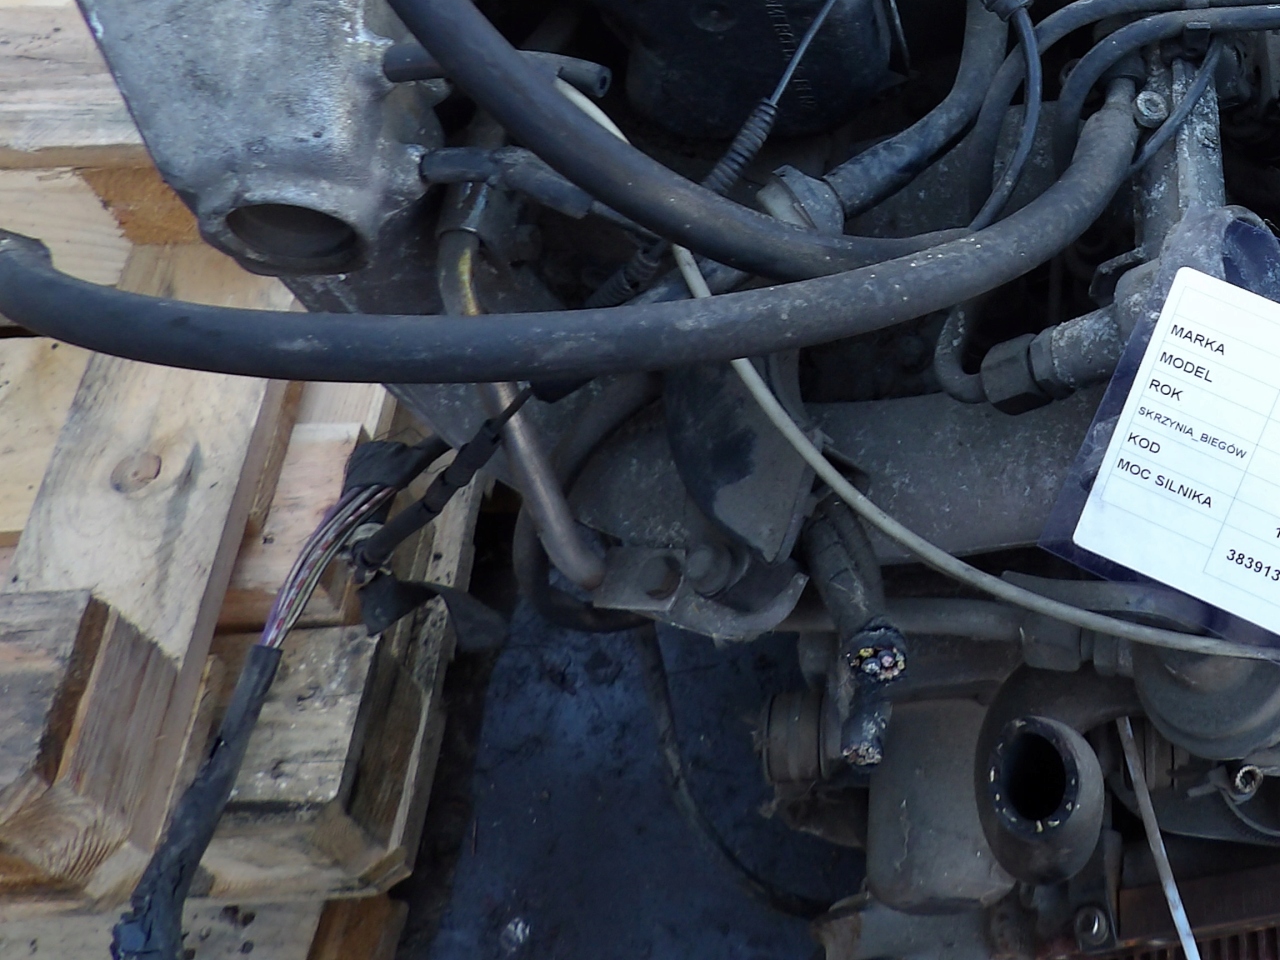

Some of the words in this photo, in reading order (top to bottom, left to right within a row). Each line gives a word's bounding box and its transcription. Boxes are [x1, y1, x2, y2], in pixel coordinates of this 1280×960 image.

[1170, 324, 1225, 356] MARKA
[1159, 351, 1213, 383] MODEL
[1148, 378, 1184, 401] ROK
[1127, 432, 1161, 454] KOD
[1116, 458, 1152, 480] MOC
[1154, 474, 1212, 509] SILNIKA
